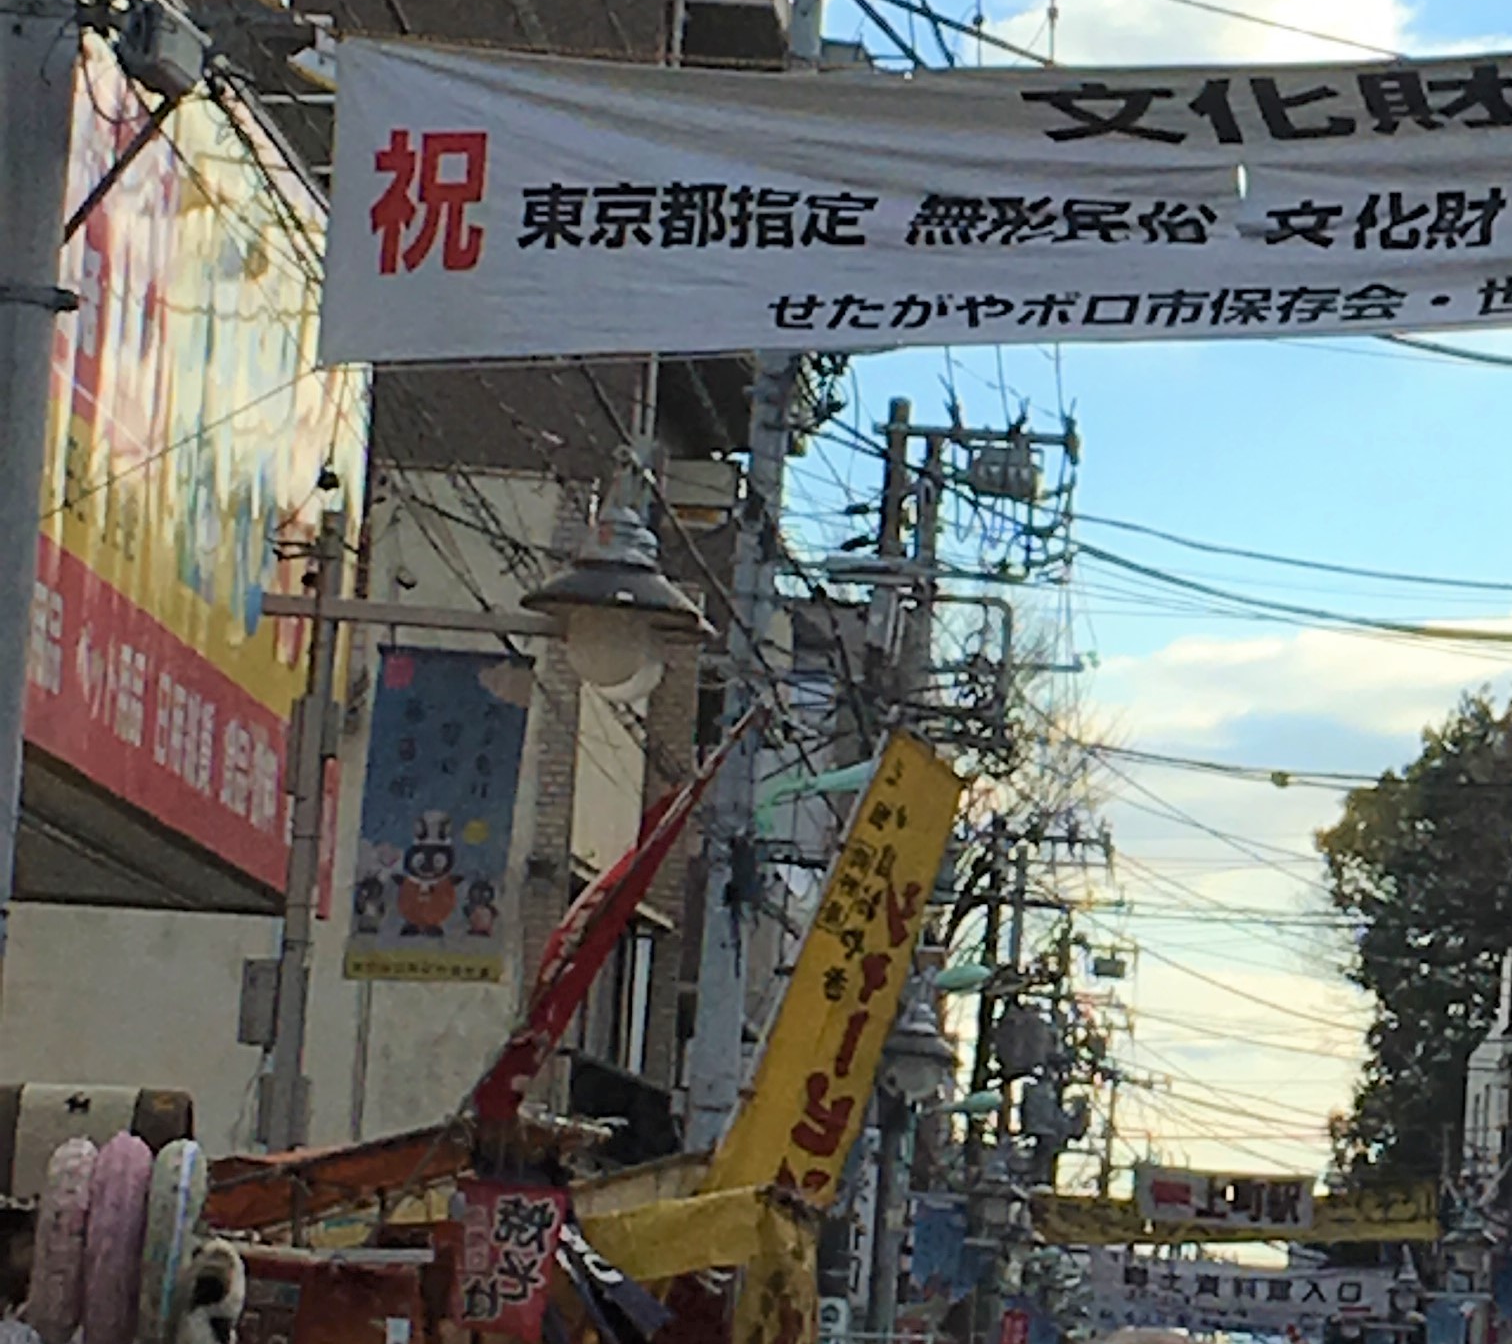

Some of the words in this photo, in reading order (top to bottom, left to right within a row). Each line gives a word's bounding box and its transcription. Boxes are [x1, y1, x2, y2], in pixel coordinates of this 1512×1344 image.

[371, 129, 488, 275] 祝
[517, 182, 878, 249] 東京都指定
